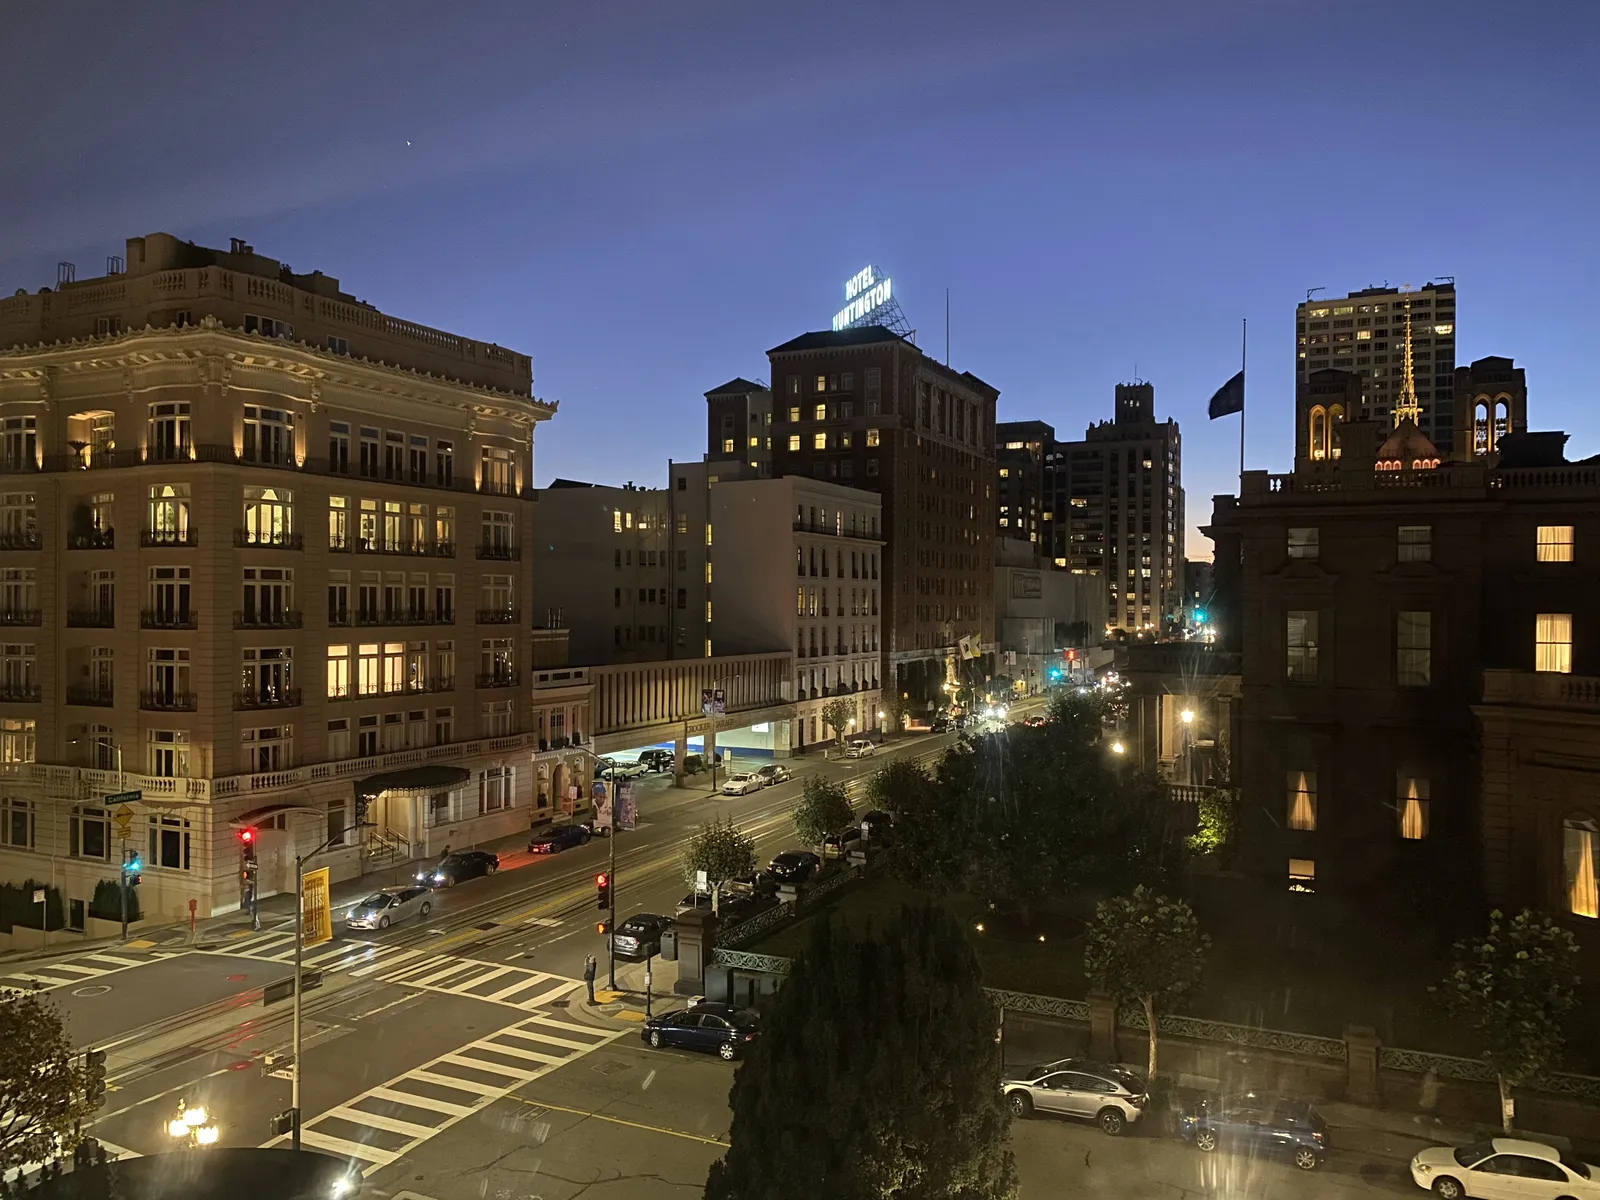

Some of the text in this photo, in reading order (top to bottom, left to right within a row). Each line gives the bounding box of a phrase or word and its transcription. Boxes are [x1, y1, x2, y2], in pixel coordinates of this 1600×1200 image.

[845, 264, 875, 301] HOTEL
[832, 277, 892, 332] HUNTINGTON
[687, 722, 711, 733] CROCKER
[108, 793, 139, 803] California
